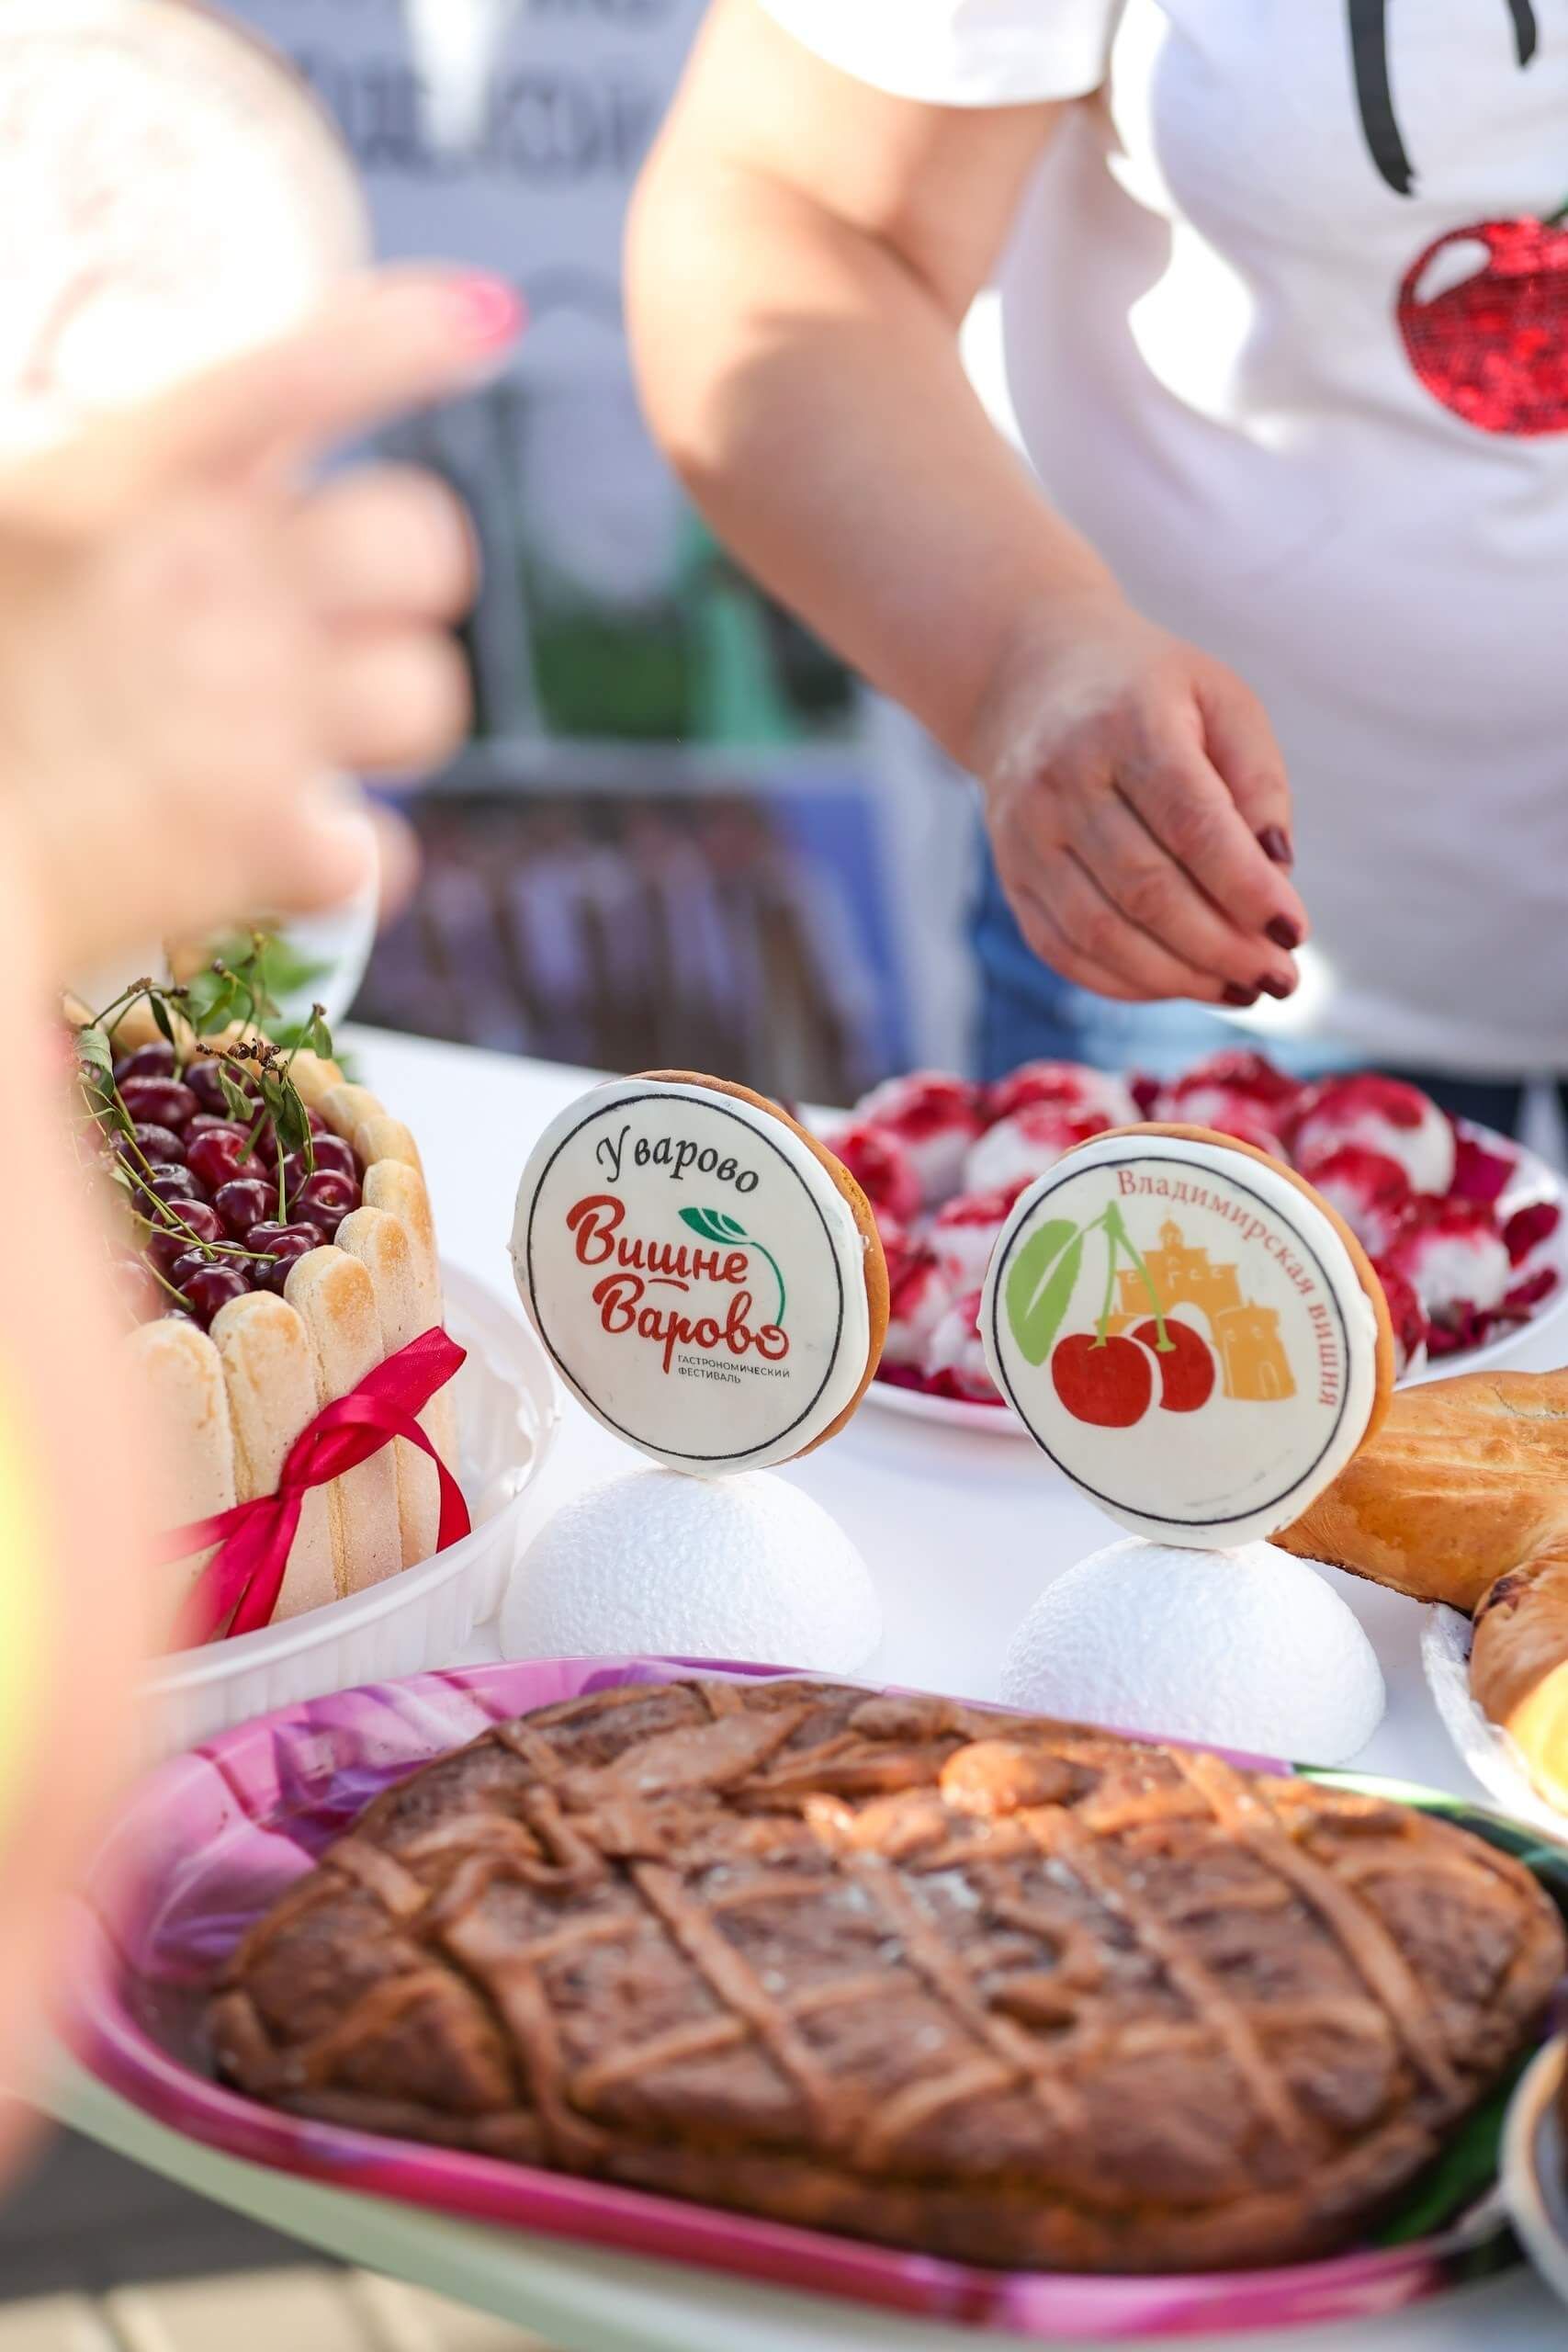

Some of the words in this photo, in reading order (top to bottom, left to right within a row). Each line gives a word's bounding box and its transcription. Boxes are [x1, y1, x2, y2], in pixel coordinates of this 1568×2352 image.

[595, 1125, 760, 1193] Уварово
[566, 1194, 749, 1283] Вишне
[1116, 1170, 1314, 1296] Владимирская
[592, 1272, 790, 1374] Варово
[677, 1353, 790, 1378] ГАСТРОНОМИЧЕСКИЙ
[677, 1366, 741, 1385] ФЕСТИВАЛЬ
